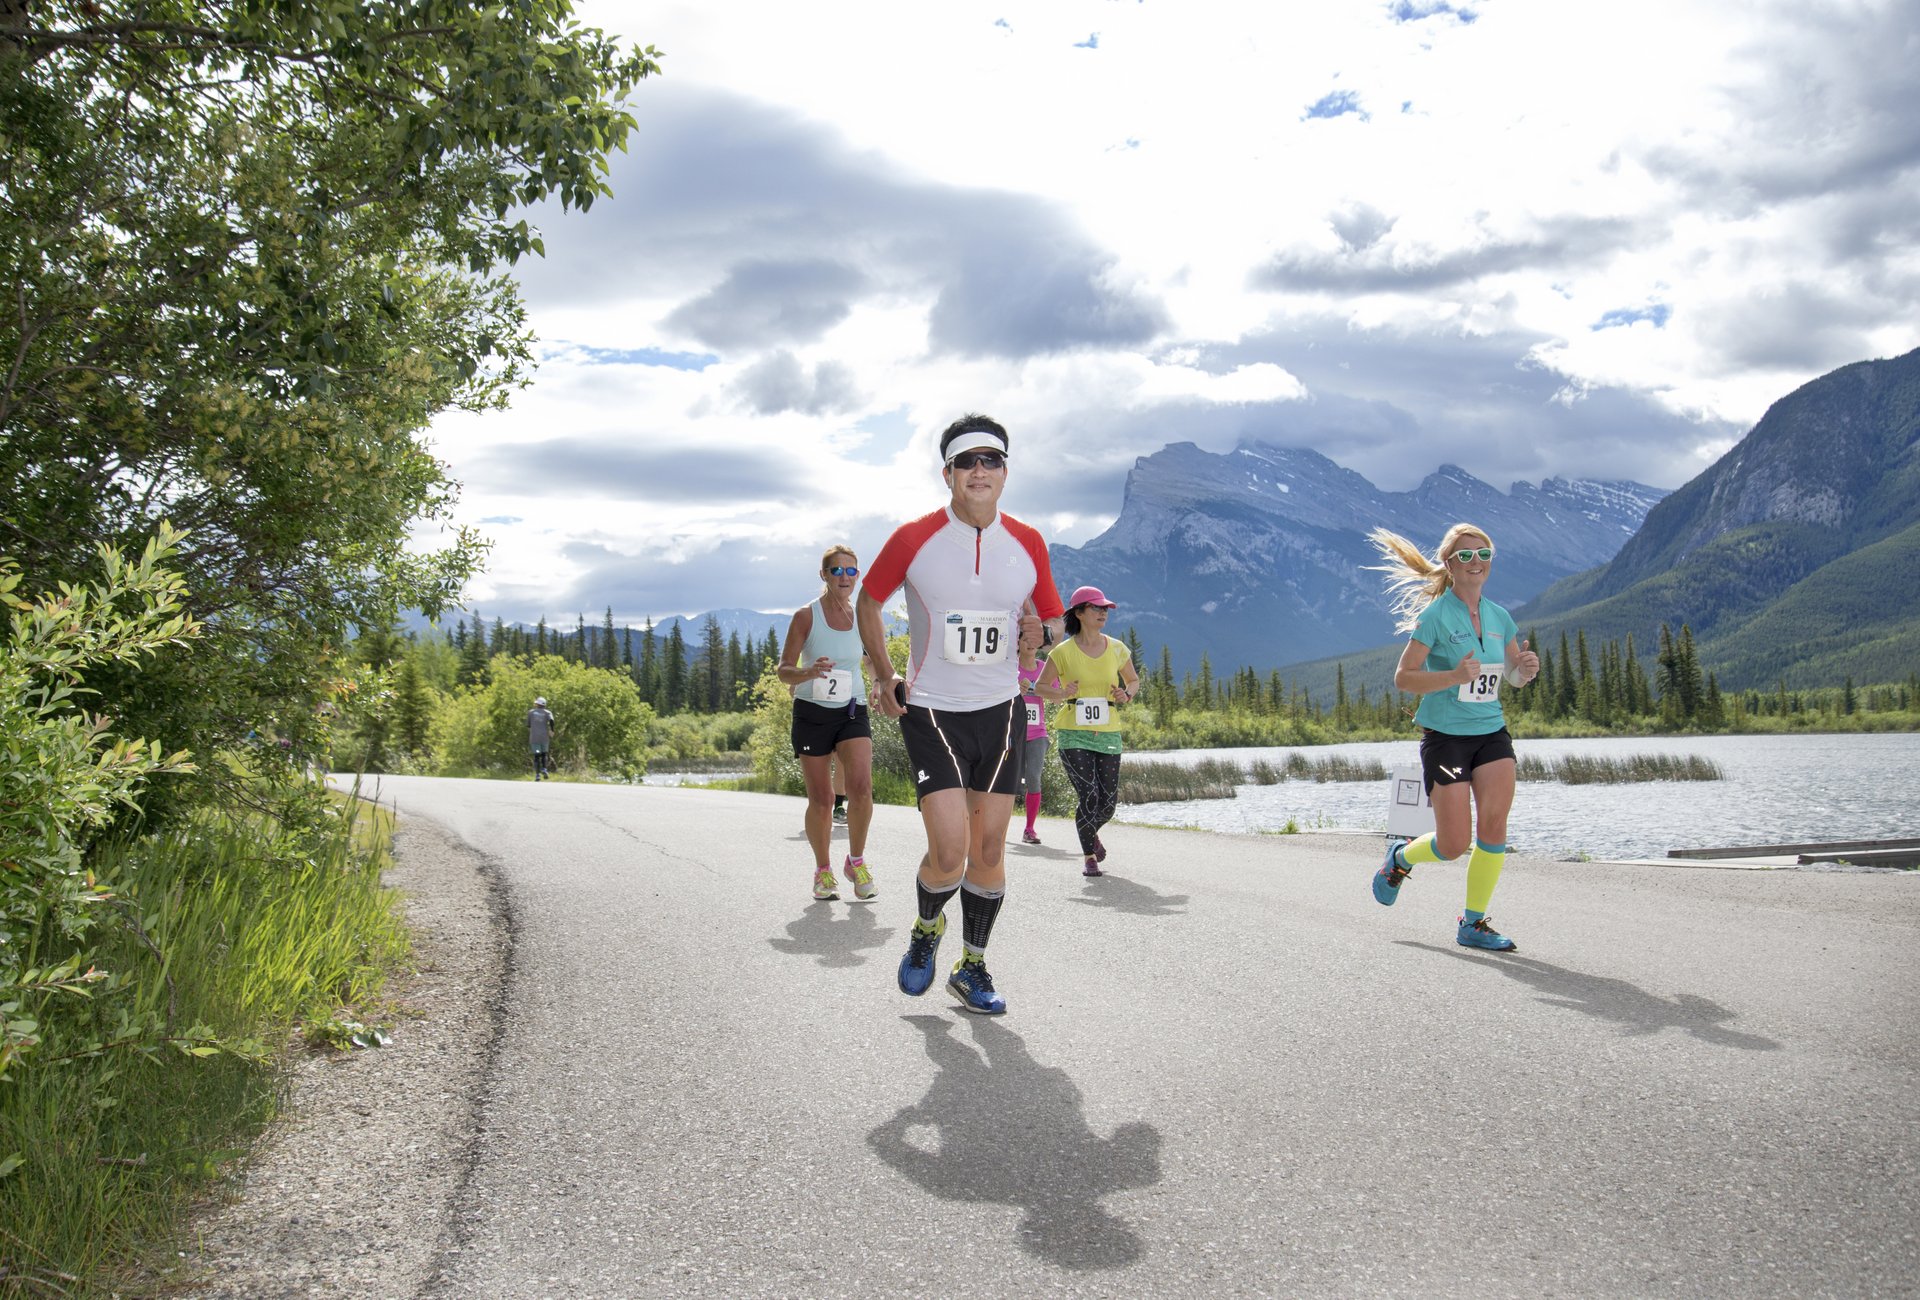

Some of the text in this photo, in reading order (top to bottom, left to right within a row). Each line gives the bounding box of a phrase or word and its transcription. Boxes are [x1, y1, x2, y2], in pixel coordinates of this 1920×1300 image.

[958, 626, 999, 655] 119
[828, 678, 837, 696] 2
[1085, 705, 1100, 720] 90
